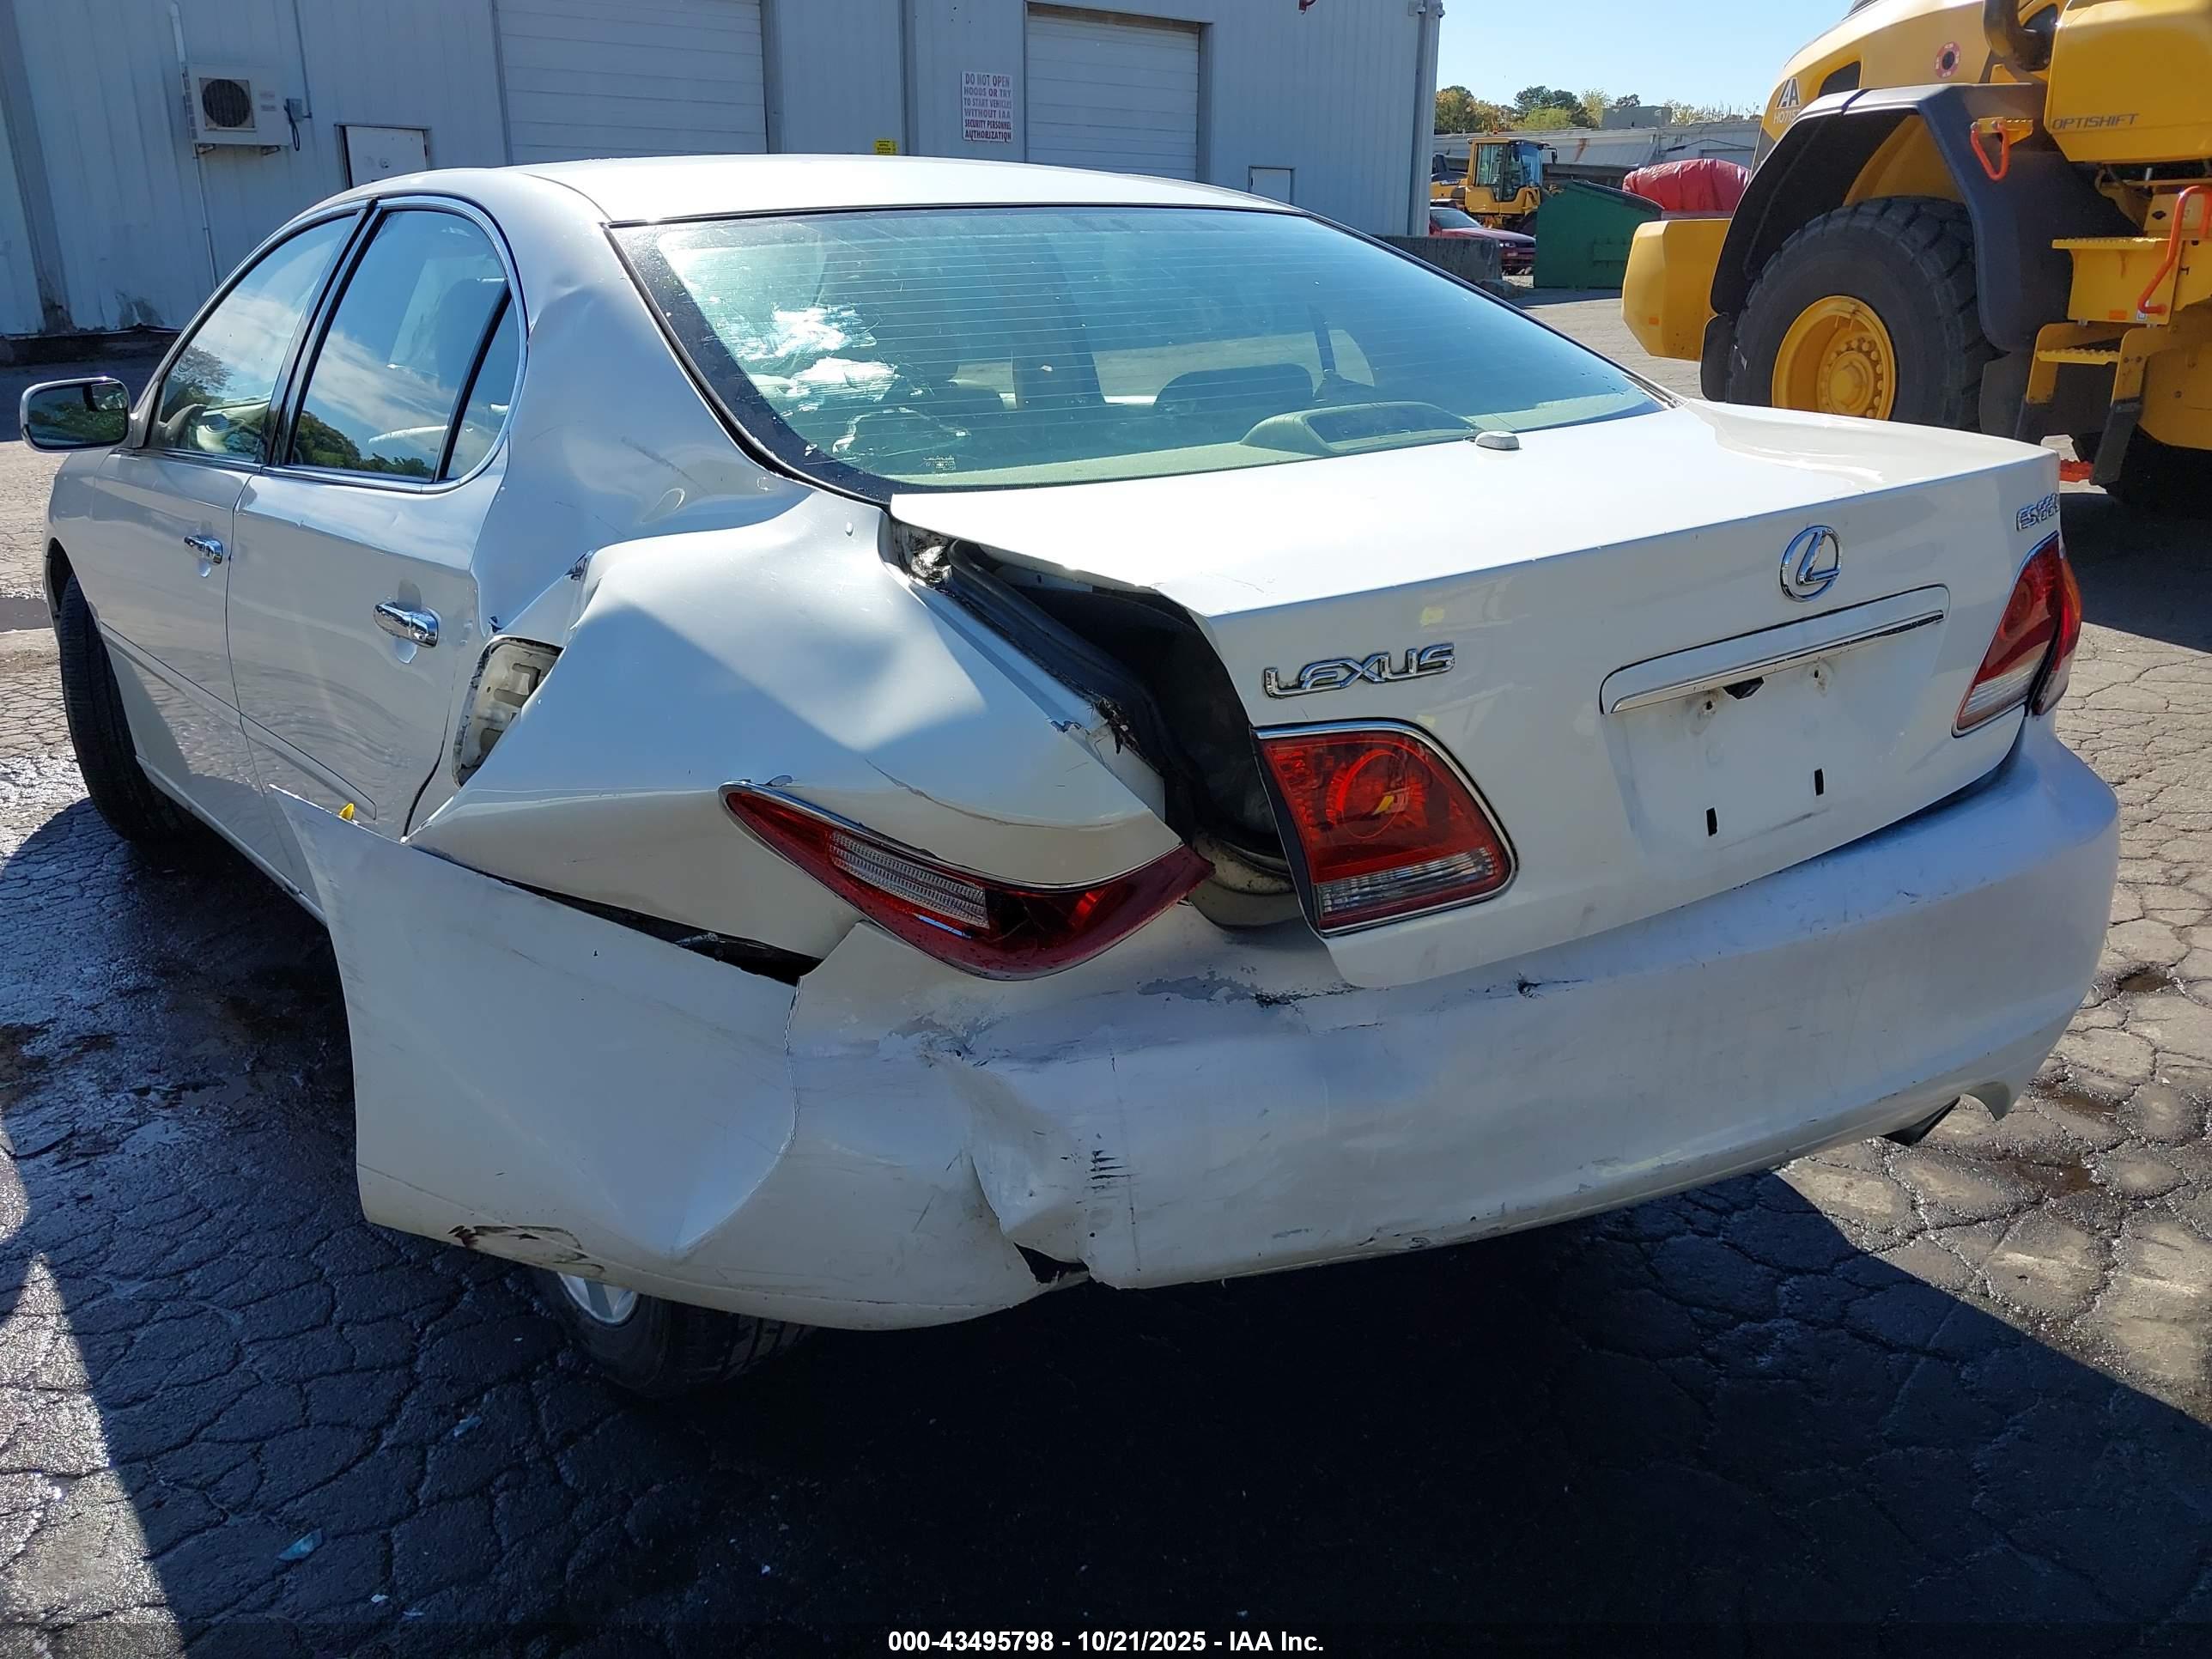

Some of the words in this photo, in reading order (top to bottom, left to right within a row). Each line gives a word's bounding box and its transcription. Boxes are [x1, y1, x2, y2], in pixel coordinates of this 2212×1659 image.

[965, 73, 975, 84] DO
[977, 74, 990, 86] NOT
[992, 76, 1010, 88] OPEN
[963, 87, 987, 96] HOODS
[988, 88, 998, 97] OR
[1000, 88, 1012, 98] TRY
[963, 98, 971, 106] TO
[972, 98, 988, 108] START
[964, 108, 996, 118] WITHOUT
[999, 110, 1011, 119] IAA
[964, 118, 986, 129] SECURITY
[987, 120, 1012, 131] PERSONNEL
[2051, 112, 2139, 131] OPTISHIFT
[964, 129, 1012, 140] AUTHORIZATION
[1263, 642, 1456, 700] LEXUS
